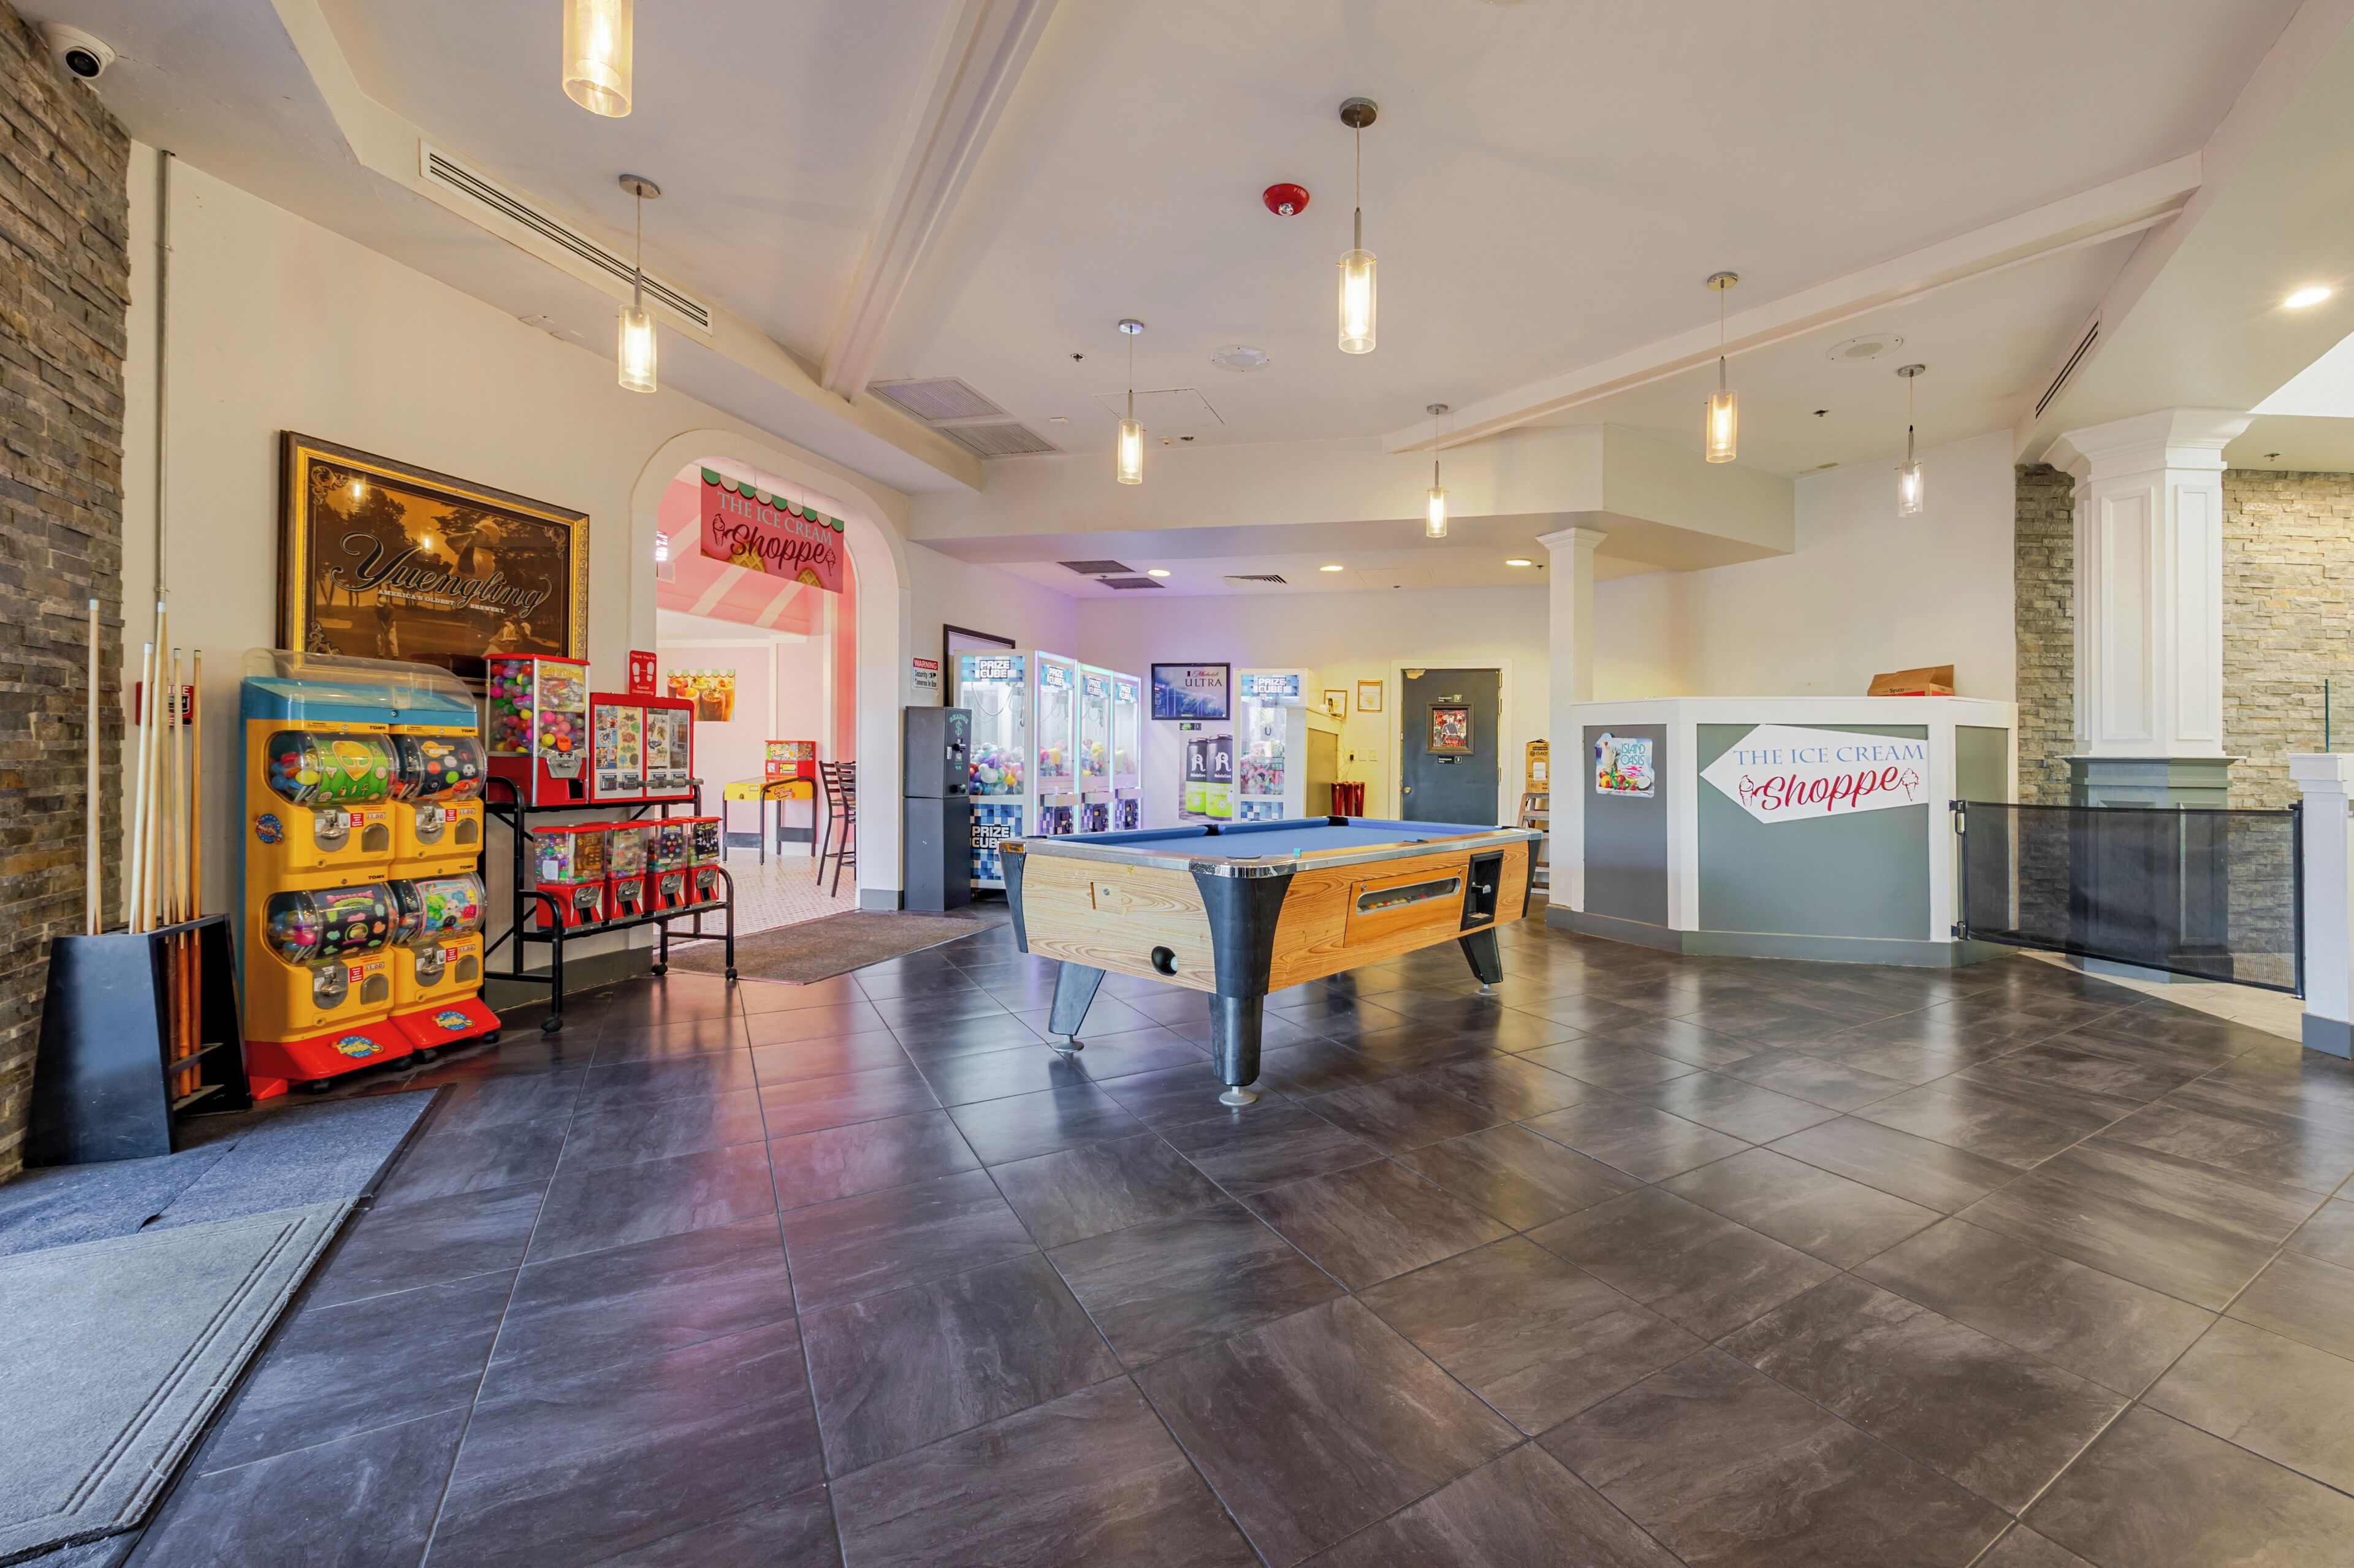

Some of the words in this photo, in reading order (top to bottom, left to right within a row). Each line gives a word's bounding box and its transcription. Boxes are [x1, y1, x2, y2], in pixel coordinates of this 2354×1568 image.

[717, 490, 752, 519] THE
[756, 506, 780, 528] ICE
[784, 517, 832, 546] CREAM
[724, 523, 826, 571] Shoppe
[329, 531, 552, 618] Yuengling
[378, 589, 423, 601] AMERICA'S
[425, 596, 455, 606] OLDEST
[914, 659, 937, 669] WARNING
[980, 660, 1010, 669] PRIZE
[980, 669, 1008, 679] CUBE
[1049, 666, 1064, 678] PRIZE
[1049, 676, 1064, 687] CUBE
[1089, 678, 1101, 688] PRIZE
[1258, 677, 1286, 686] PRIZE
[1621, 743, 1645, 754] ISLAND
[1621, 755, 1644, 766] OASIS
[1734, 749, 1783, 765] THE
[1790, 747, 1829, 764] ICE
[1836, 745, 1925, 762] CREAM
[1753, 766, 1903, 811] Shoppe
[972, 826, 1009, 837] PRIZE
[972, 837, 997, 848] CUB
